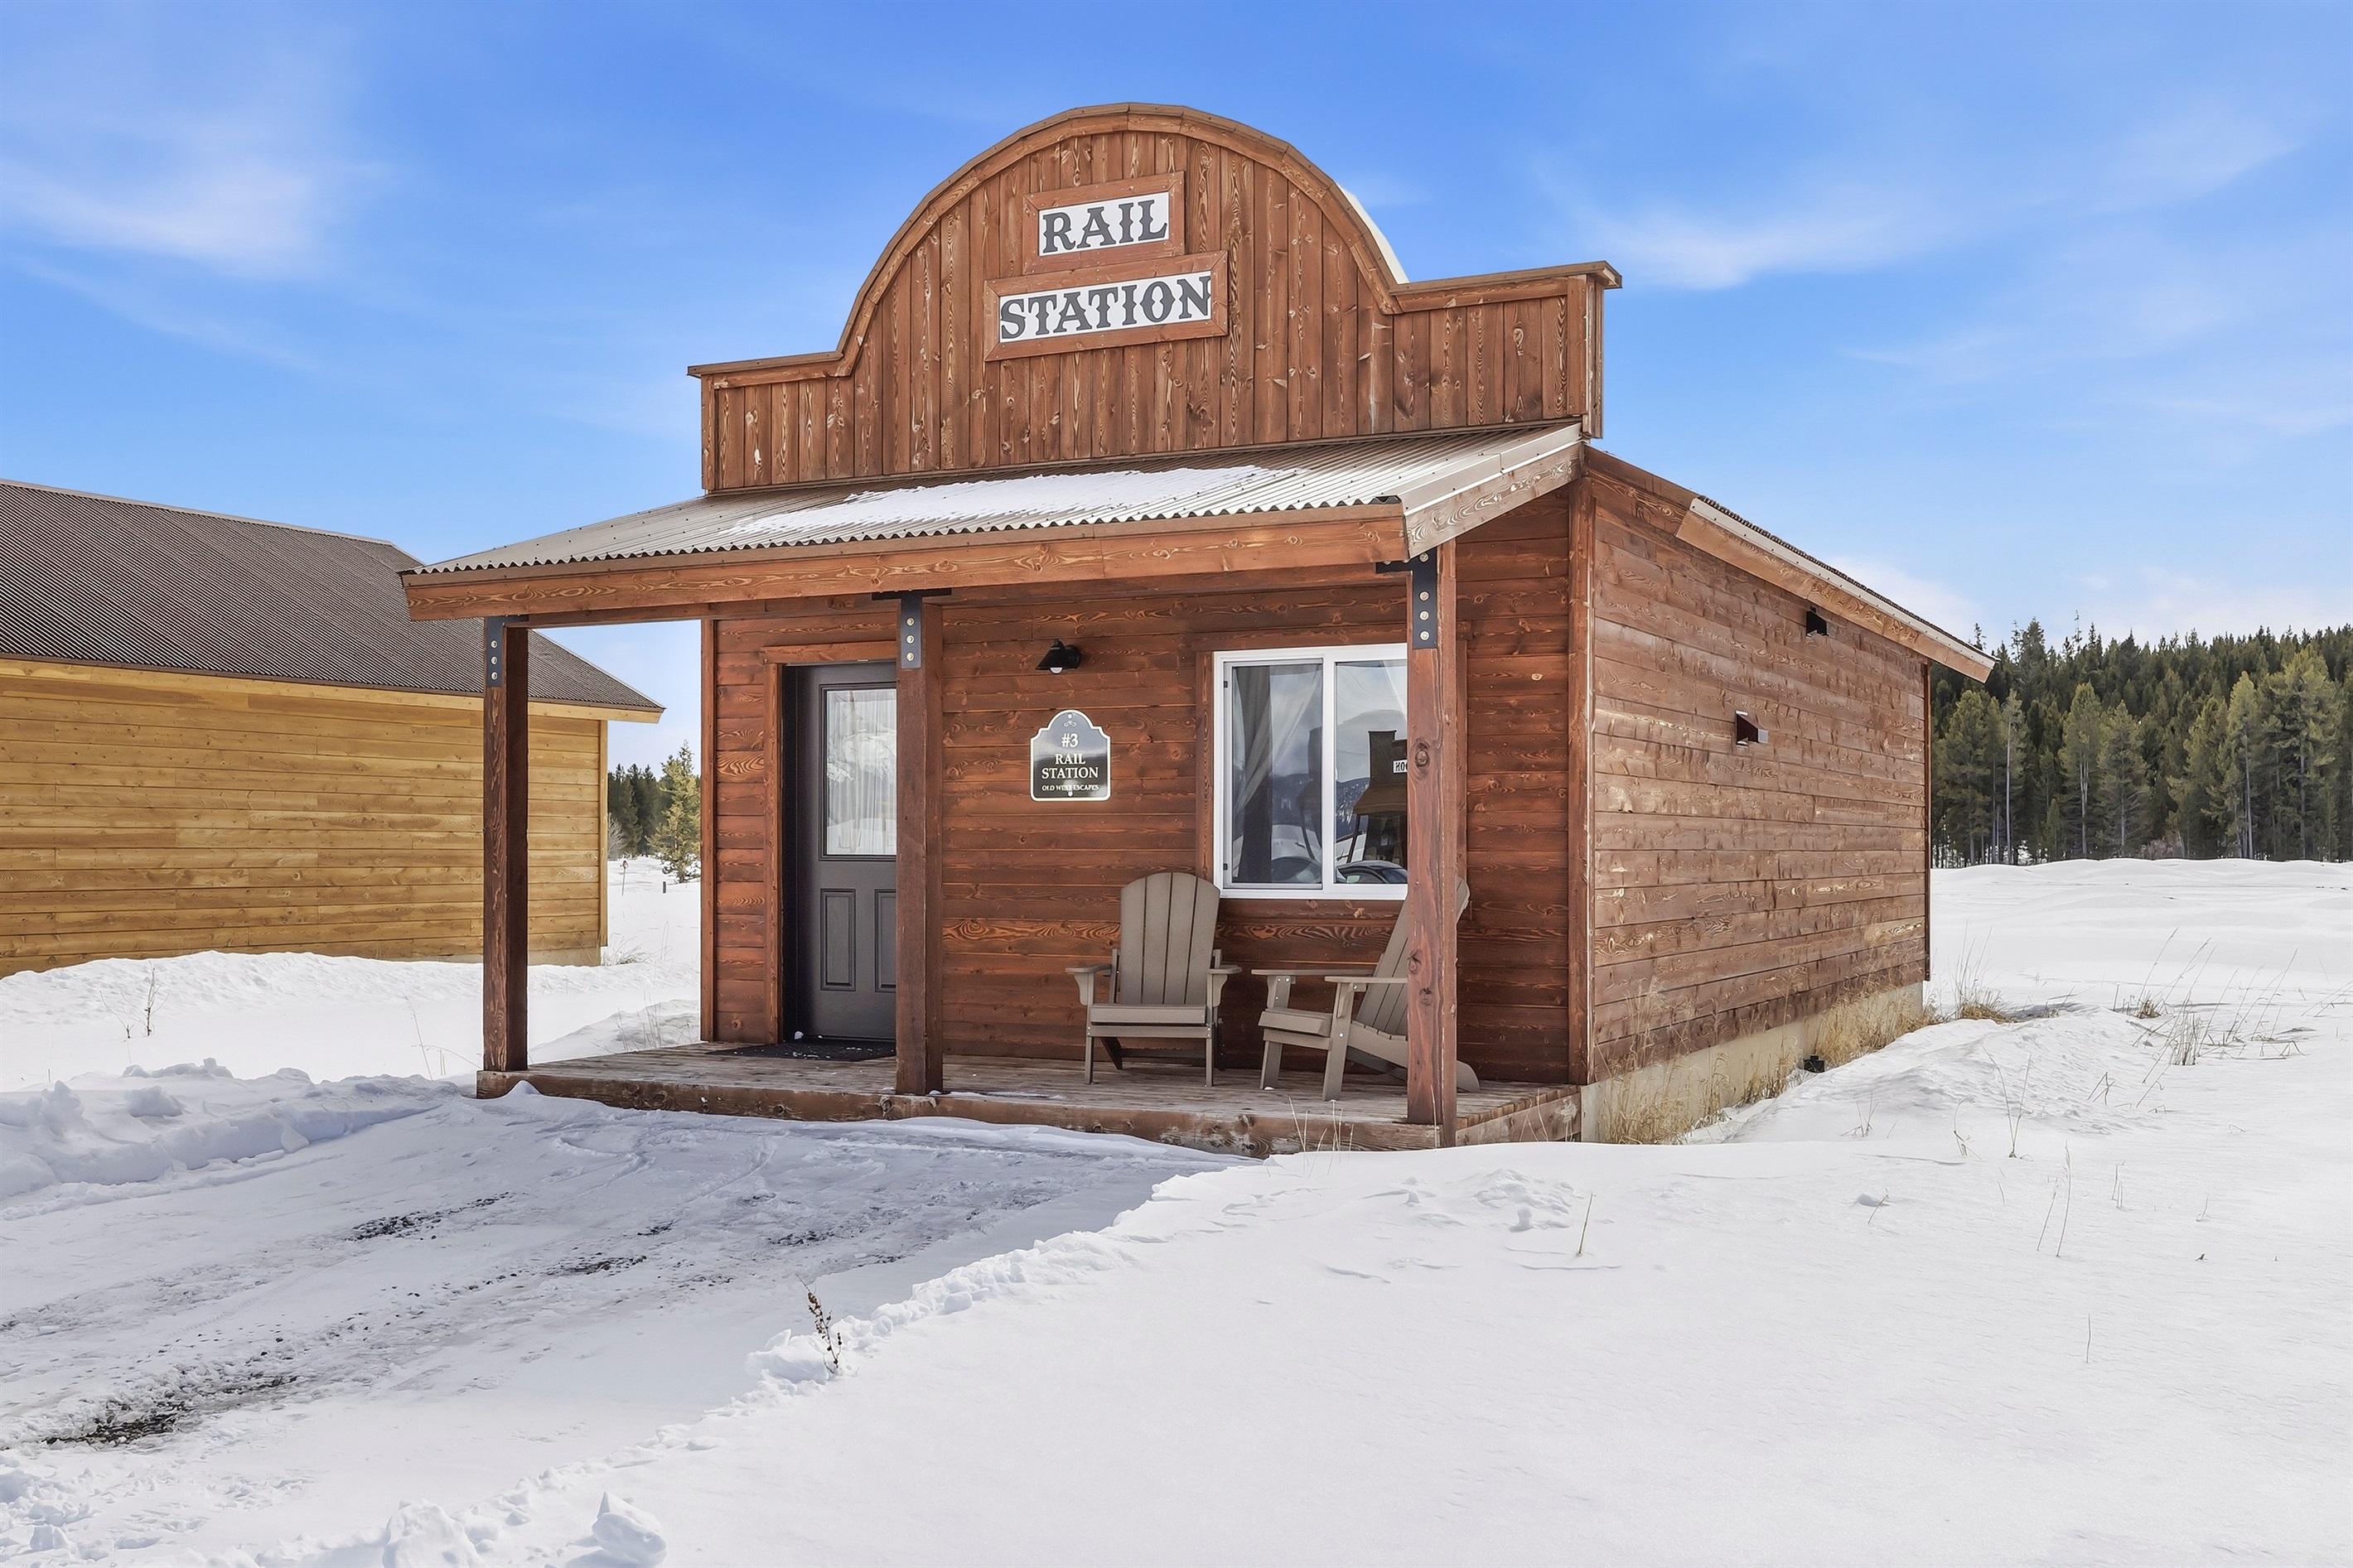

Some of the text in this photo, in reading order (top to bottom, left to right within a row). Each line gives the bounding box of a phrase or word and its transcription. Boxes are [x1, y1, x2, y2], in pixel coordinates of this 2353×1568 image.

[1042, 199, 1167, 253] RAIL
[1000, 276, 1211, 339] STATION
[1061, 733, 1079, 747] #3
[1055, 753, 1086, 765] RAIL
[1041, 767, 1099, 779] STATION
